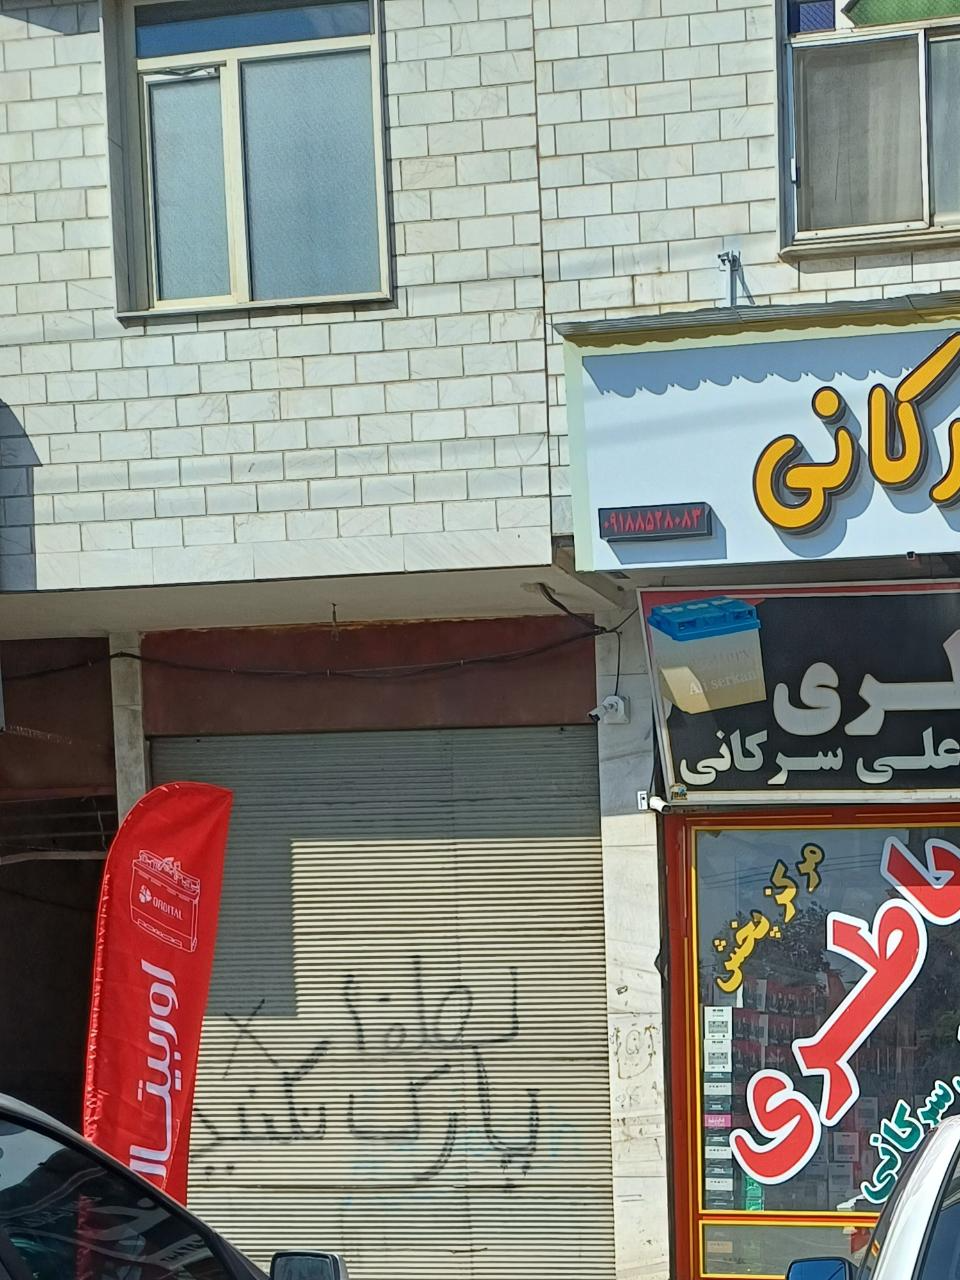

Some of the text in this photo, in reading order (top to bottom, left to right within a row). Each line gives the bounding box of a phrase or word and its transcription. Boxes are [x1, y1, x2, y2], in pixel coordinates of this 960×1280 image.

[604, 507, 702, 533] ۰۹۱۸۸۵۲۸۰۸۳
[713, 843, 826, 994] مرکز پخش
